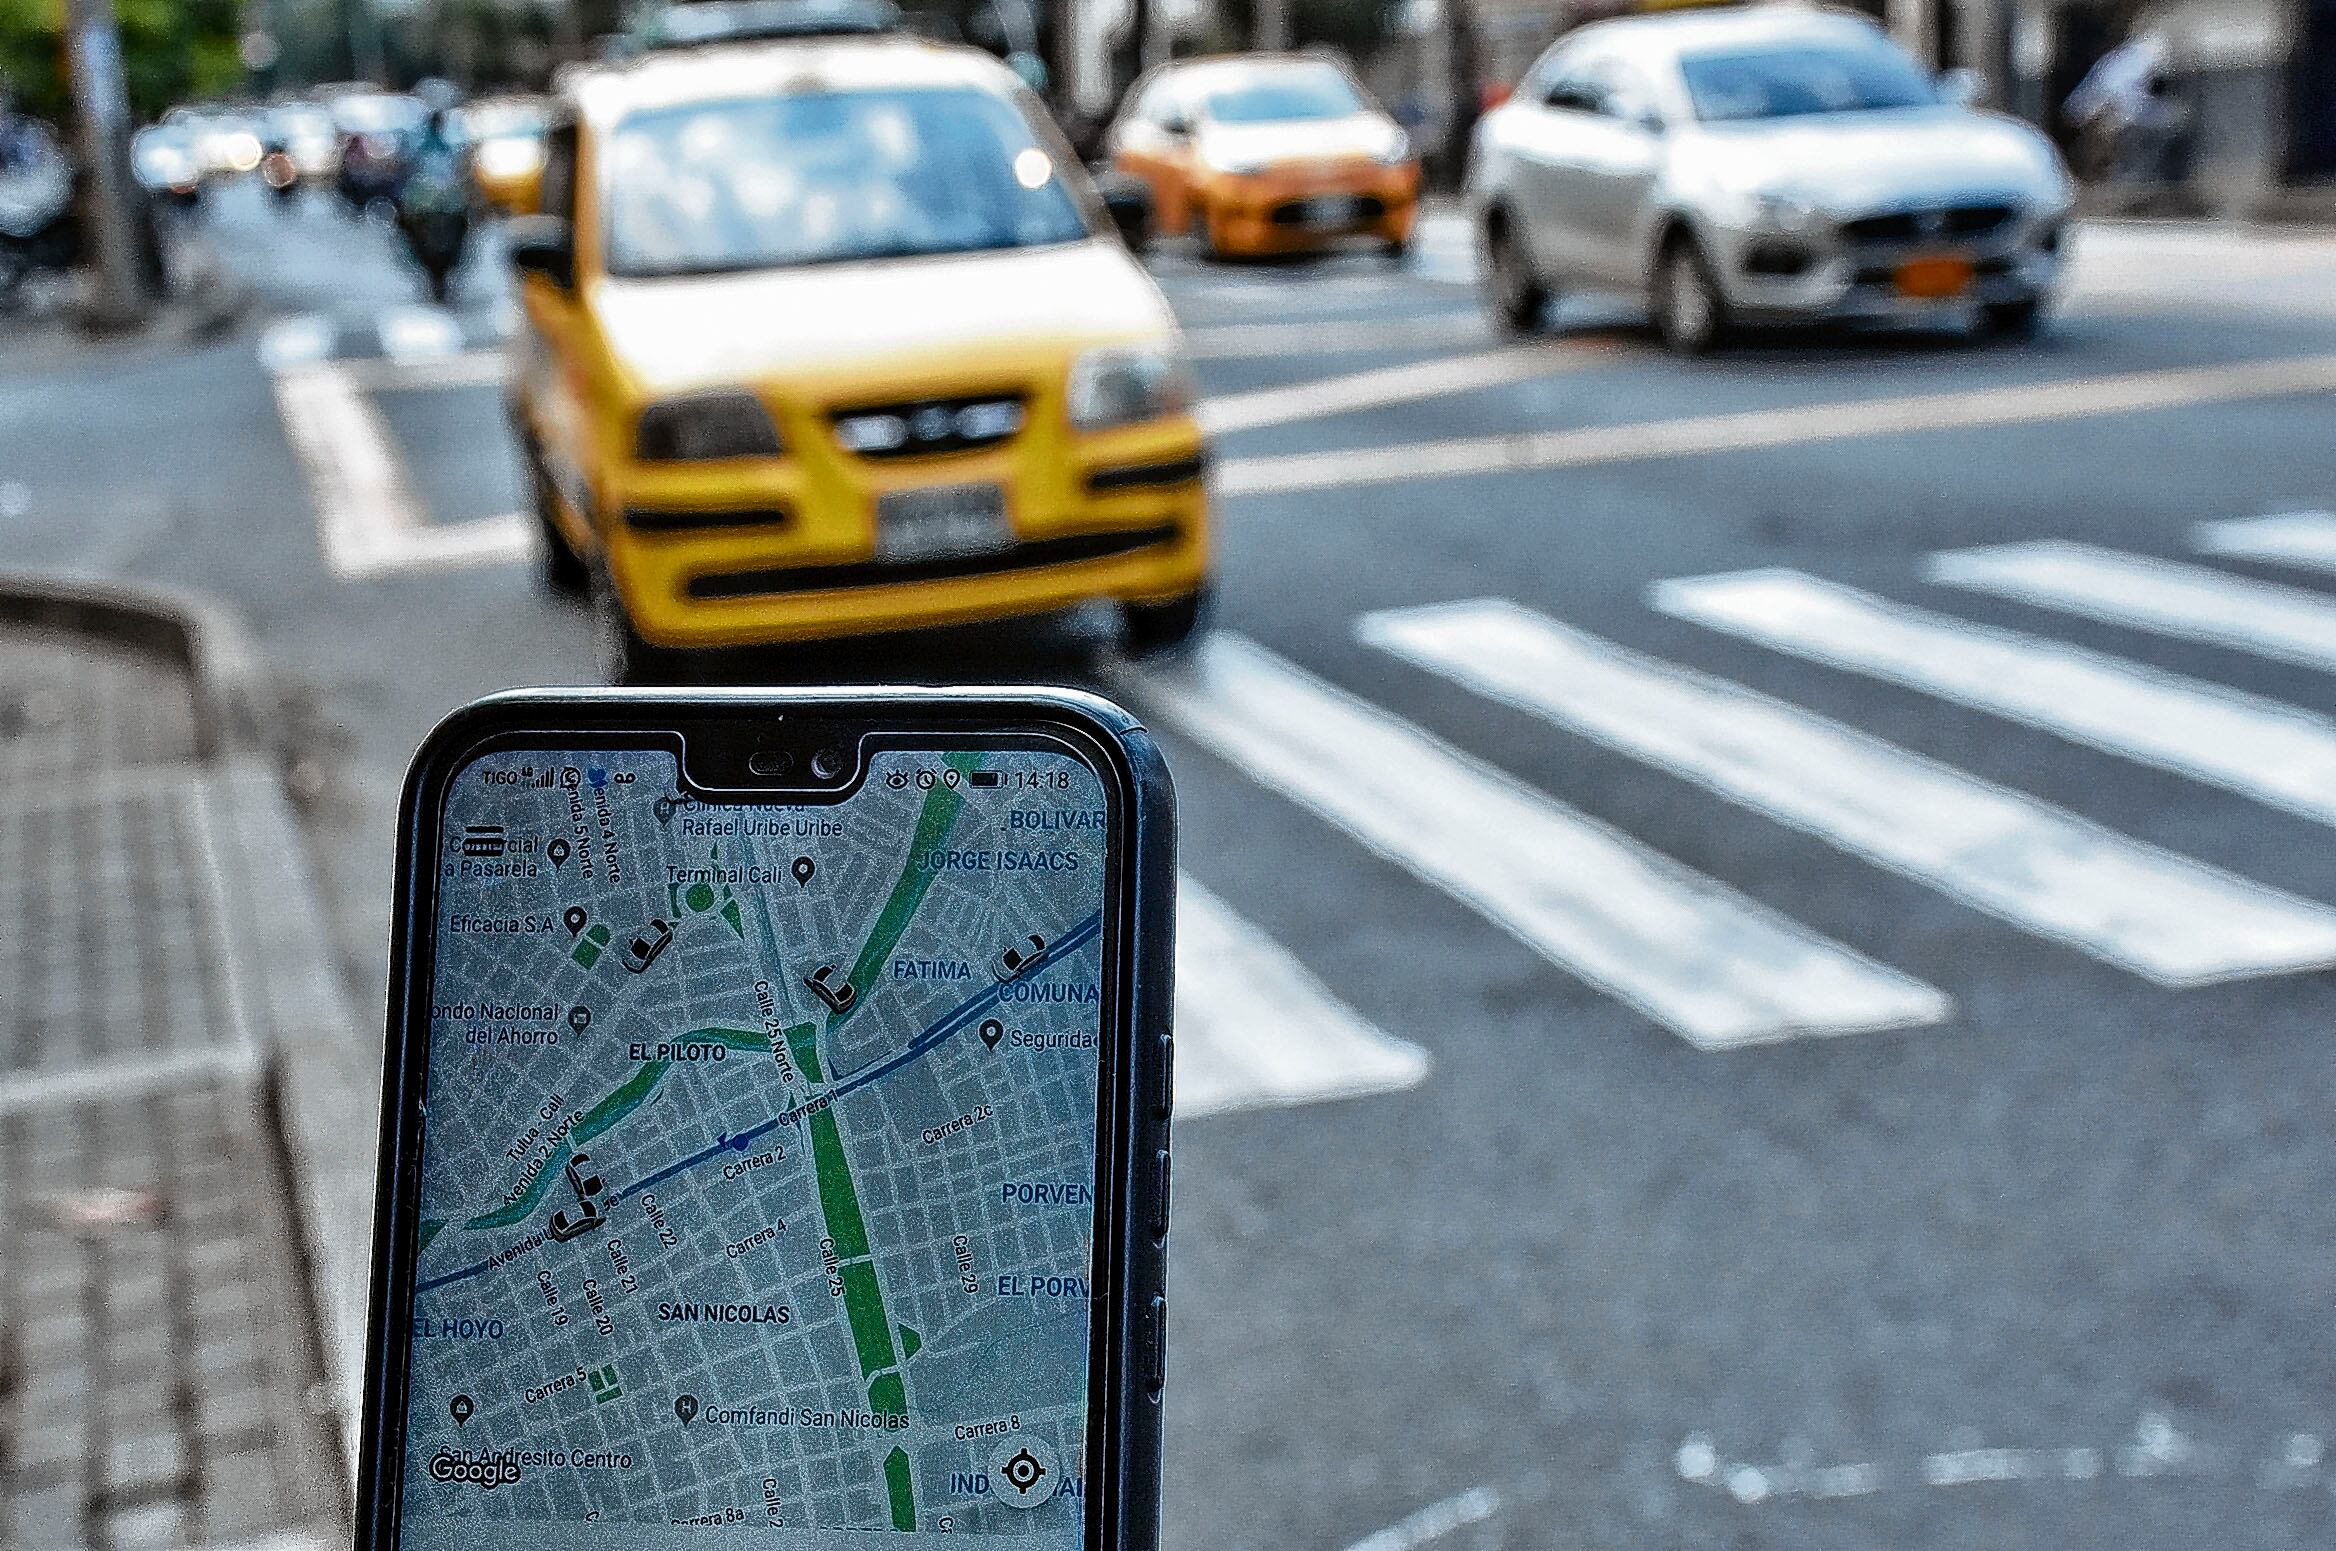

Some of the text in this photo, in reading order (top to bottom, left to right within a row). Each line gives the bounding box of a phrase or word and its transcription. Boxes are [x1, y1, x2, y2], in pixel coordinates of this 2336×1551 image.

[483, 771, 518, 785] TIGO
[1015, 771, 1069, 789] 14:18
[683, 818, 843, 837] Rafael Uribe Uribe
[1010, 810, 1106, 829] BOLIVAR
[567, 787, 594, 879] nida 5 Norte
[594, 788, 621, 883] enida 4 Norte
[444, 860, 538, 877] a Pasarela
[917, 851, 1079, 870] JORGE ISAACS
[667, 865, 782, 884] Terminal Cali
[450, 915, 554, 934] Eficacia S.A
[894, 961, 972, 980] FATIMA
[998, 983, 1099, 1003] COMUNA
[480, 1001, 559, 1020] Nacional
[466, 1025, 558, 1045] del Ahorro
[754, 981, 794, 1083] Calle 25 Norte
[629, 1043, 726, 1062] EL PILOTO
[778, 1089, 839, 1126] Carrera 1
[506, 1127, 540, 1162] Tulua
[540, 1093, 565, 1120] Cali
[923, 1104, 994, 1145] Carrera 2c
[503, 1110, 585, 1206] Avenida 2 Norte
[723, 1146, 786, 1180] Carrera 2
[1002, 1183, 1093, 1204] PORVEN
[641, 1194, 678, 1249] Calle 22
[726, 1218, 787, 1258] Carrera 4
[488, 1234, 544, 1271] Avenida
[953, 1235, 979, 1294] Calle 29
[607, 1239, 639, 1294] Calle 21
[819, 1238, 845, 1297] Calle 25
[998, 1276, 1024, 1296] EL
[537, 1270, 569, 1327] Calle 19
[583, 1279, 613, 1336] Calle 20
[658, 1303, 790, 1324] SAN NICOLAS
[413, 1319, 504, 1339] EL HOYO
[525, 1366, 588, 1404] Carrera 5
[705, 1405, 910, 1429] Comfandi San Nicolas
[955, 1415, 1021, 1440] Carrera 8
[432, 1456, 518, 1486] Google
[571, 1449, 632, 1469] Centro
[762, 1478, 781, 1516] Calle
[725, 1507, 745, 1523] 8a
